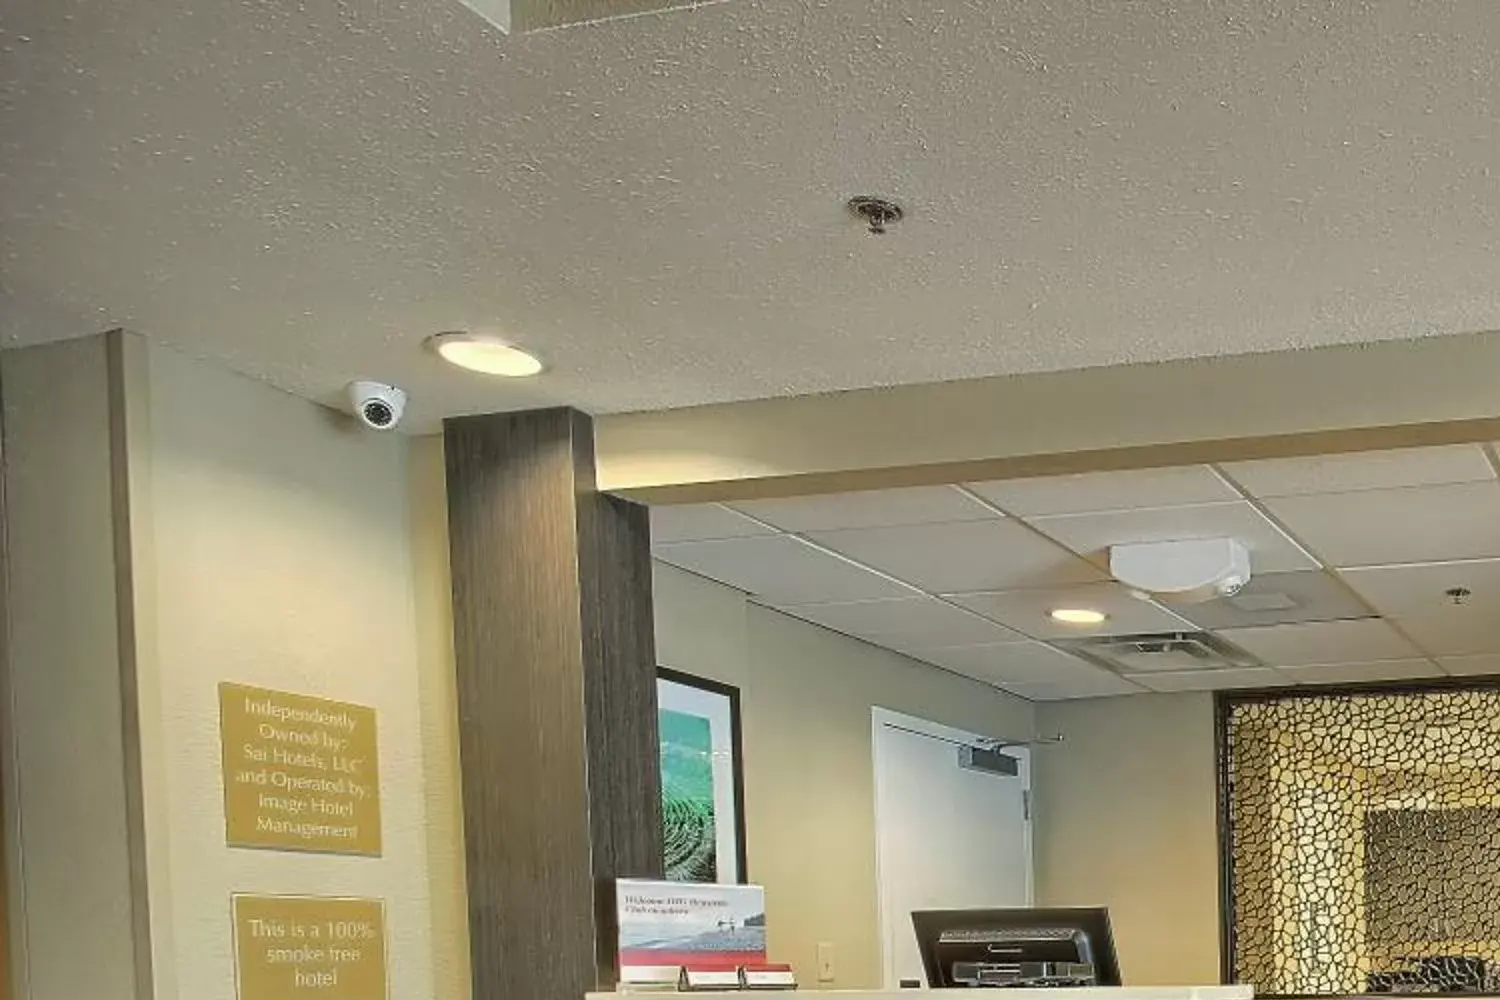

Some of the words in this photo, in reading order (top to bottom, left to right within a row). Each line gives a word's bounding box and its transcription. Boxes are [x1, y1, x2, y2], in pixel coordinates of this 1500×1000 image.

[244, 697, 357, 733] Independently
[258, 723, 318, 746] Owned
[236, 768, 266, 786] and
[271, 769, 344, 793] Operated
[258, 792, 307, 815] Image
[312, 799, 353, 817] Hotel
[255, 814, 358, 841] Management
[248, 919, 285, 938] This
[291, 919, 305, 937] is
[310, 925, 320, 938] a
[327, 921, 376, 940] 100%
[266, 943, 324, 964] smoke
[329, 943, 361, 962] free
[295, 968, 338, 989] hotel
